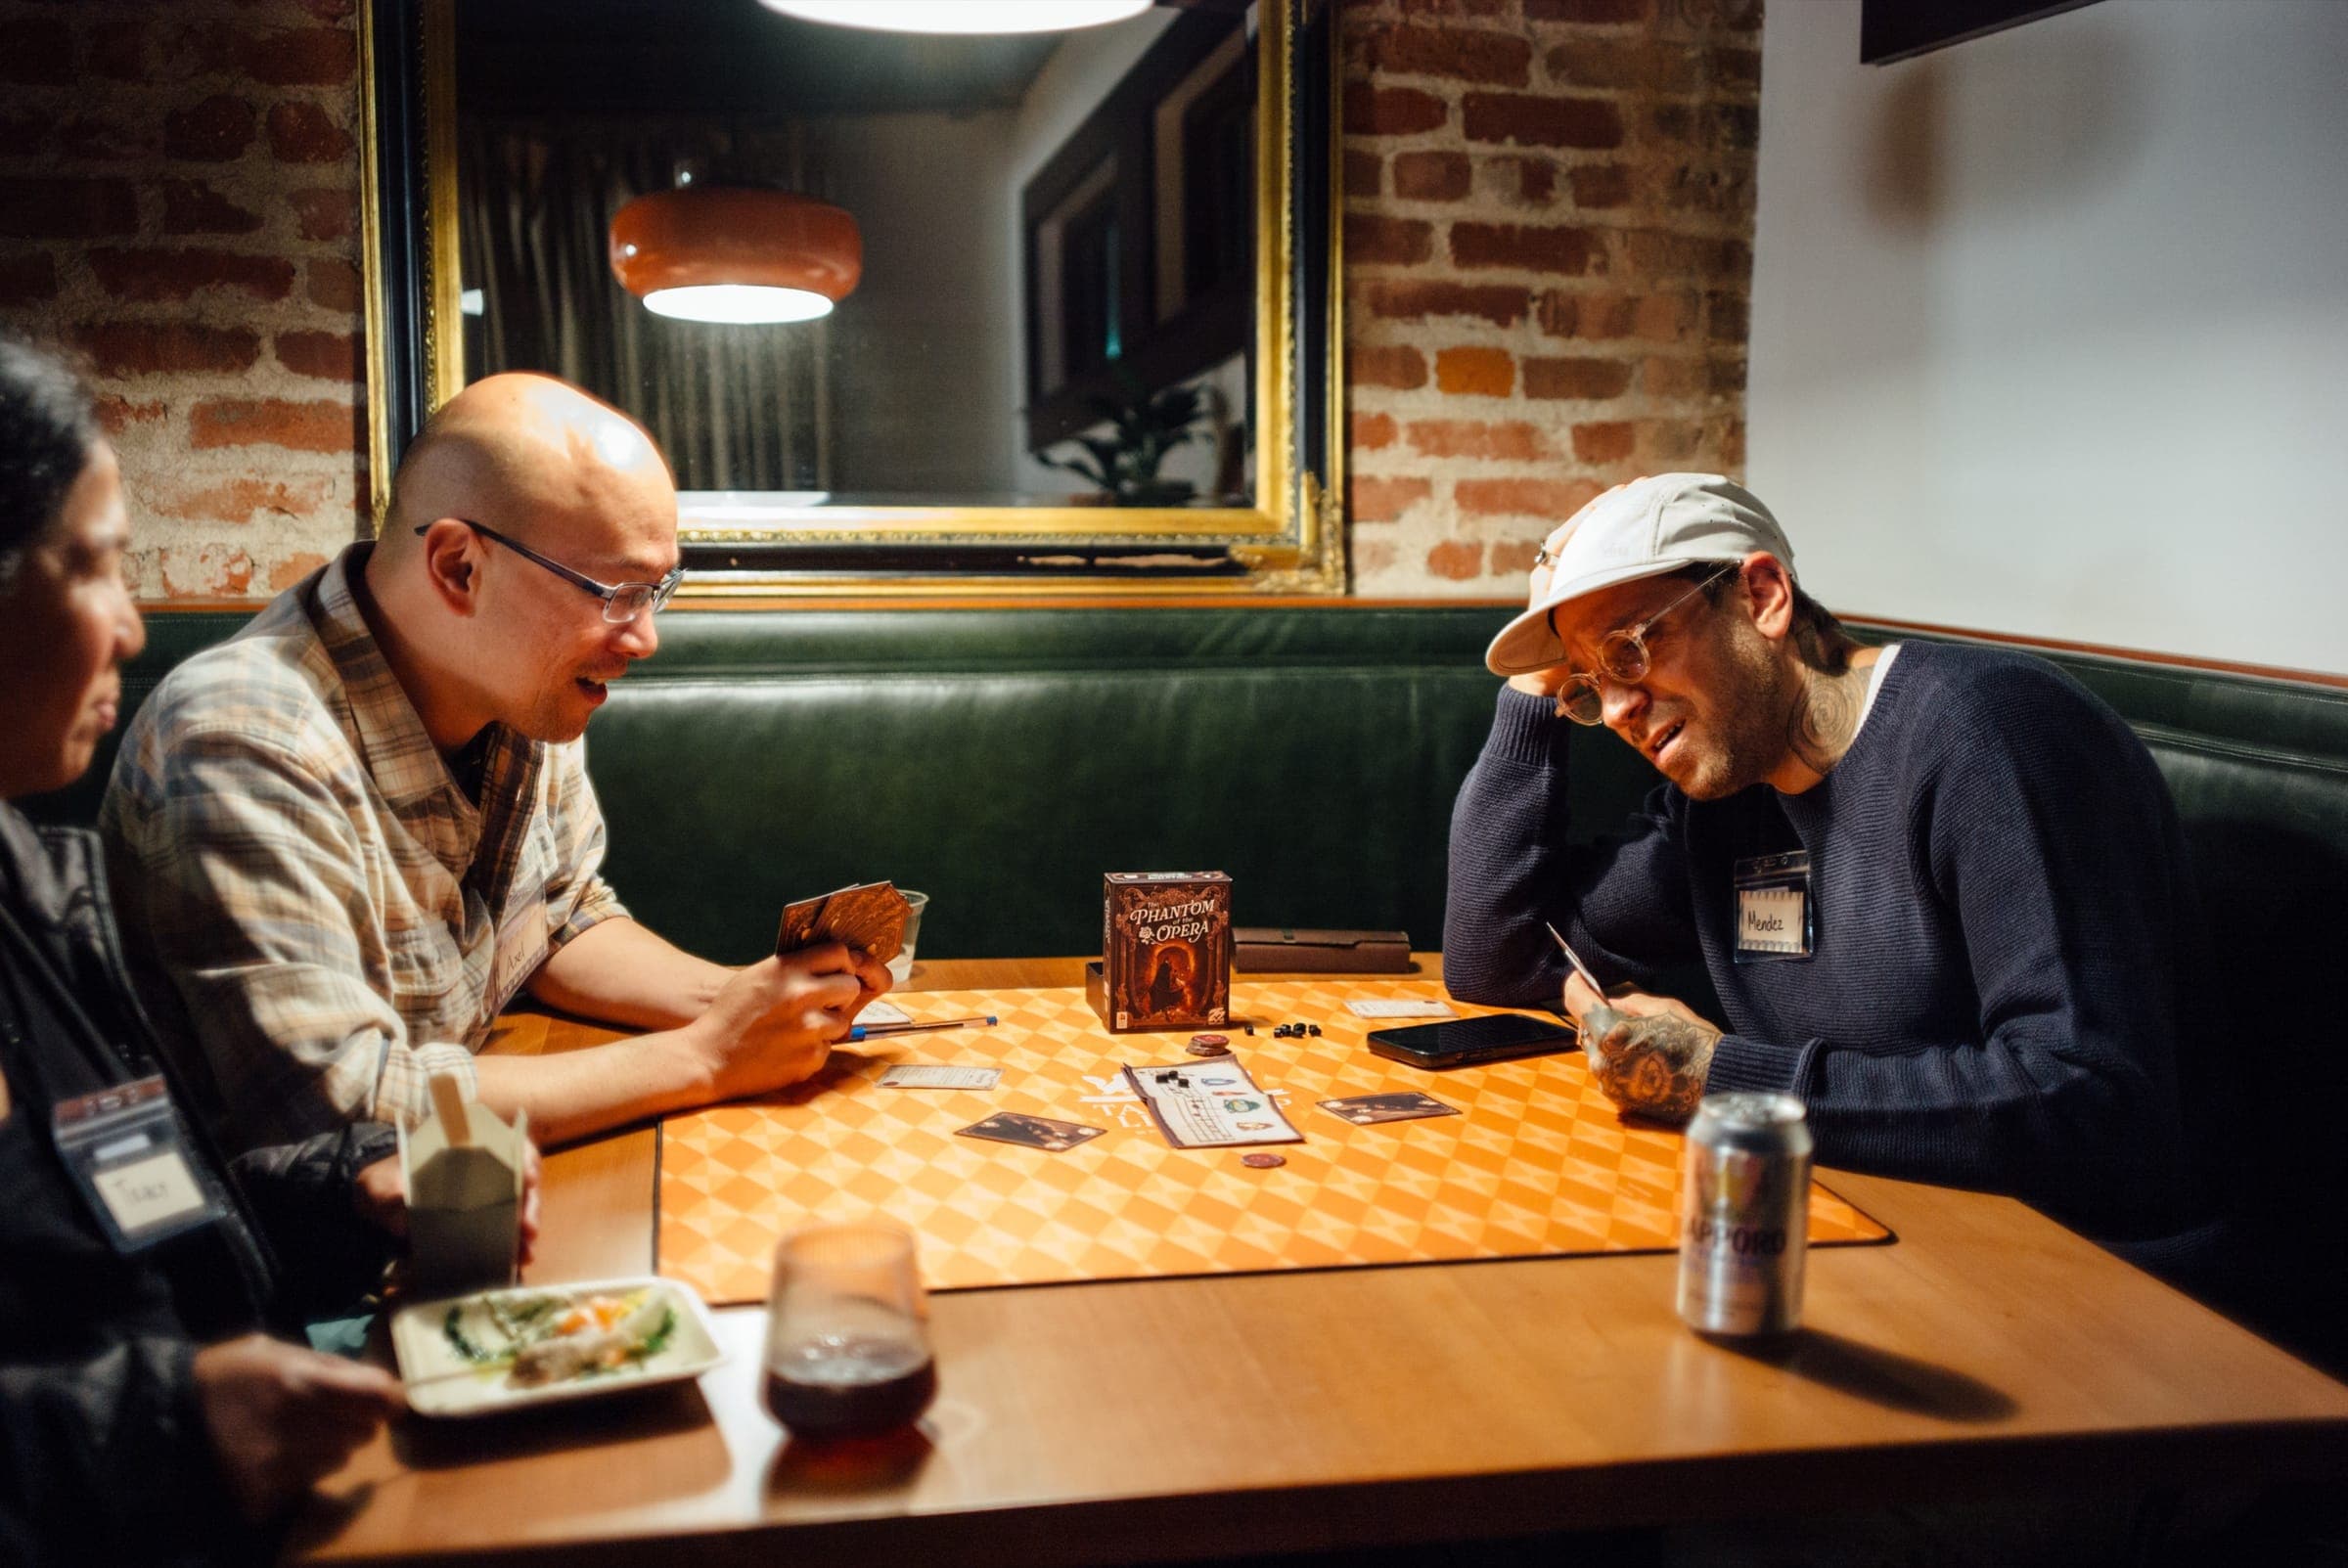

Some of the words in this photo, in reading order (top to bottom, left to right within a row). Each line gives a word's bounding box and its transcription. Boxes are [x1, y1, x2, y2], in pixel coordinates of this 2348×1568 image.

[1129, 899, 1214, 925] PHANTOM
[1747, 910, 1784, 932] Mendez
[1156, 919, 1209, 944] OPERA
